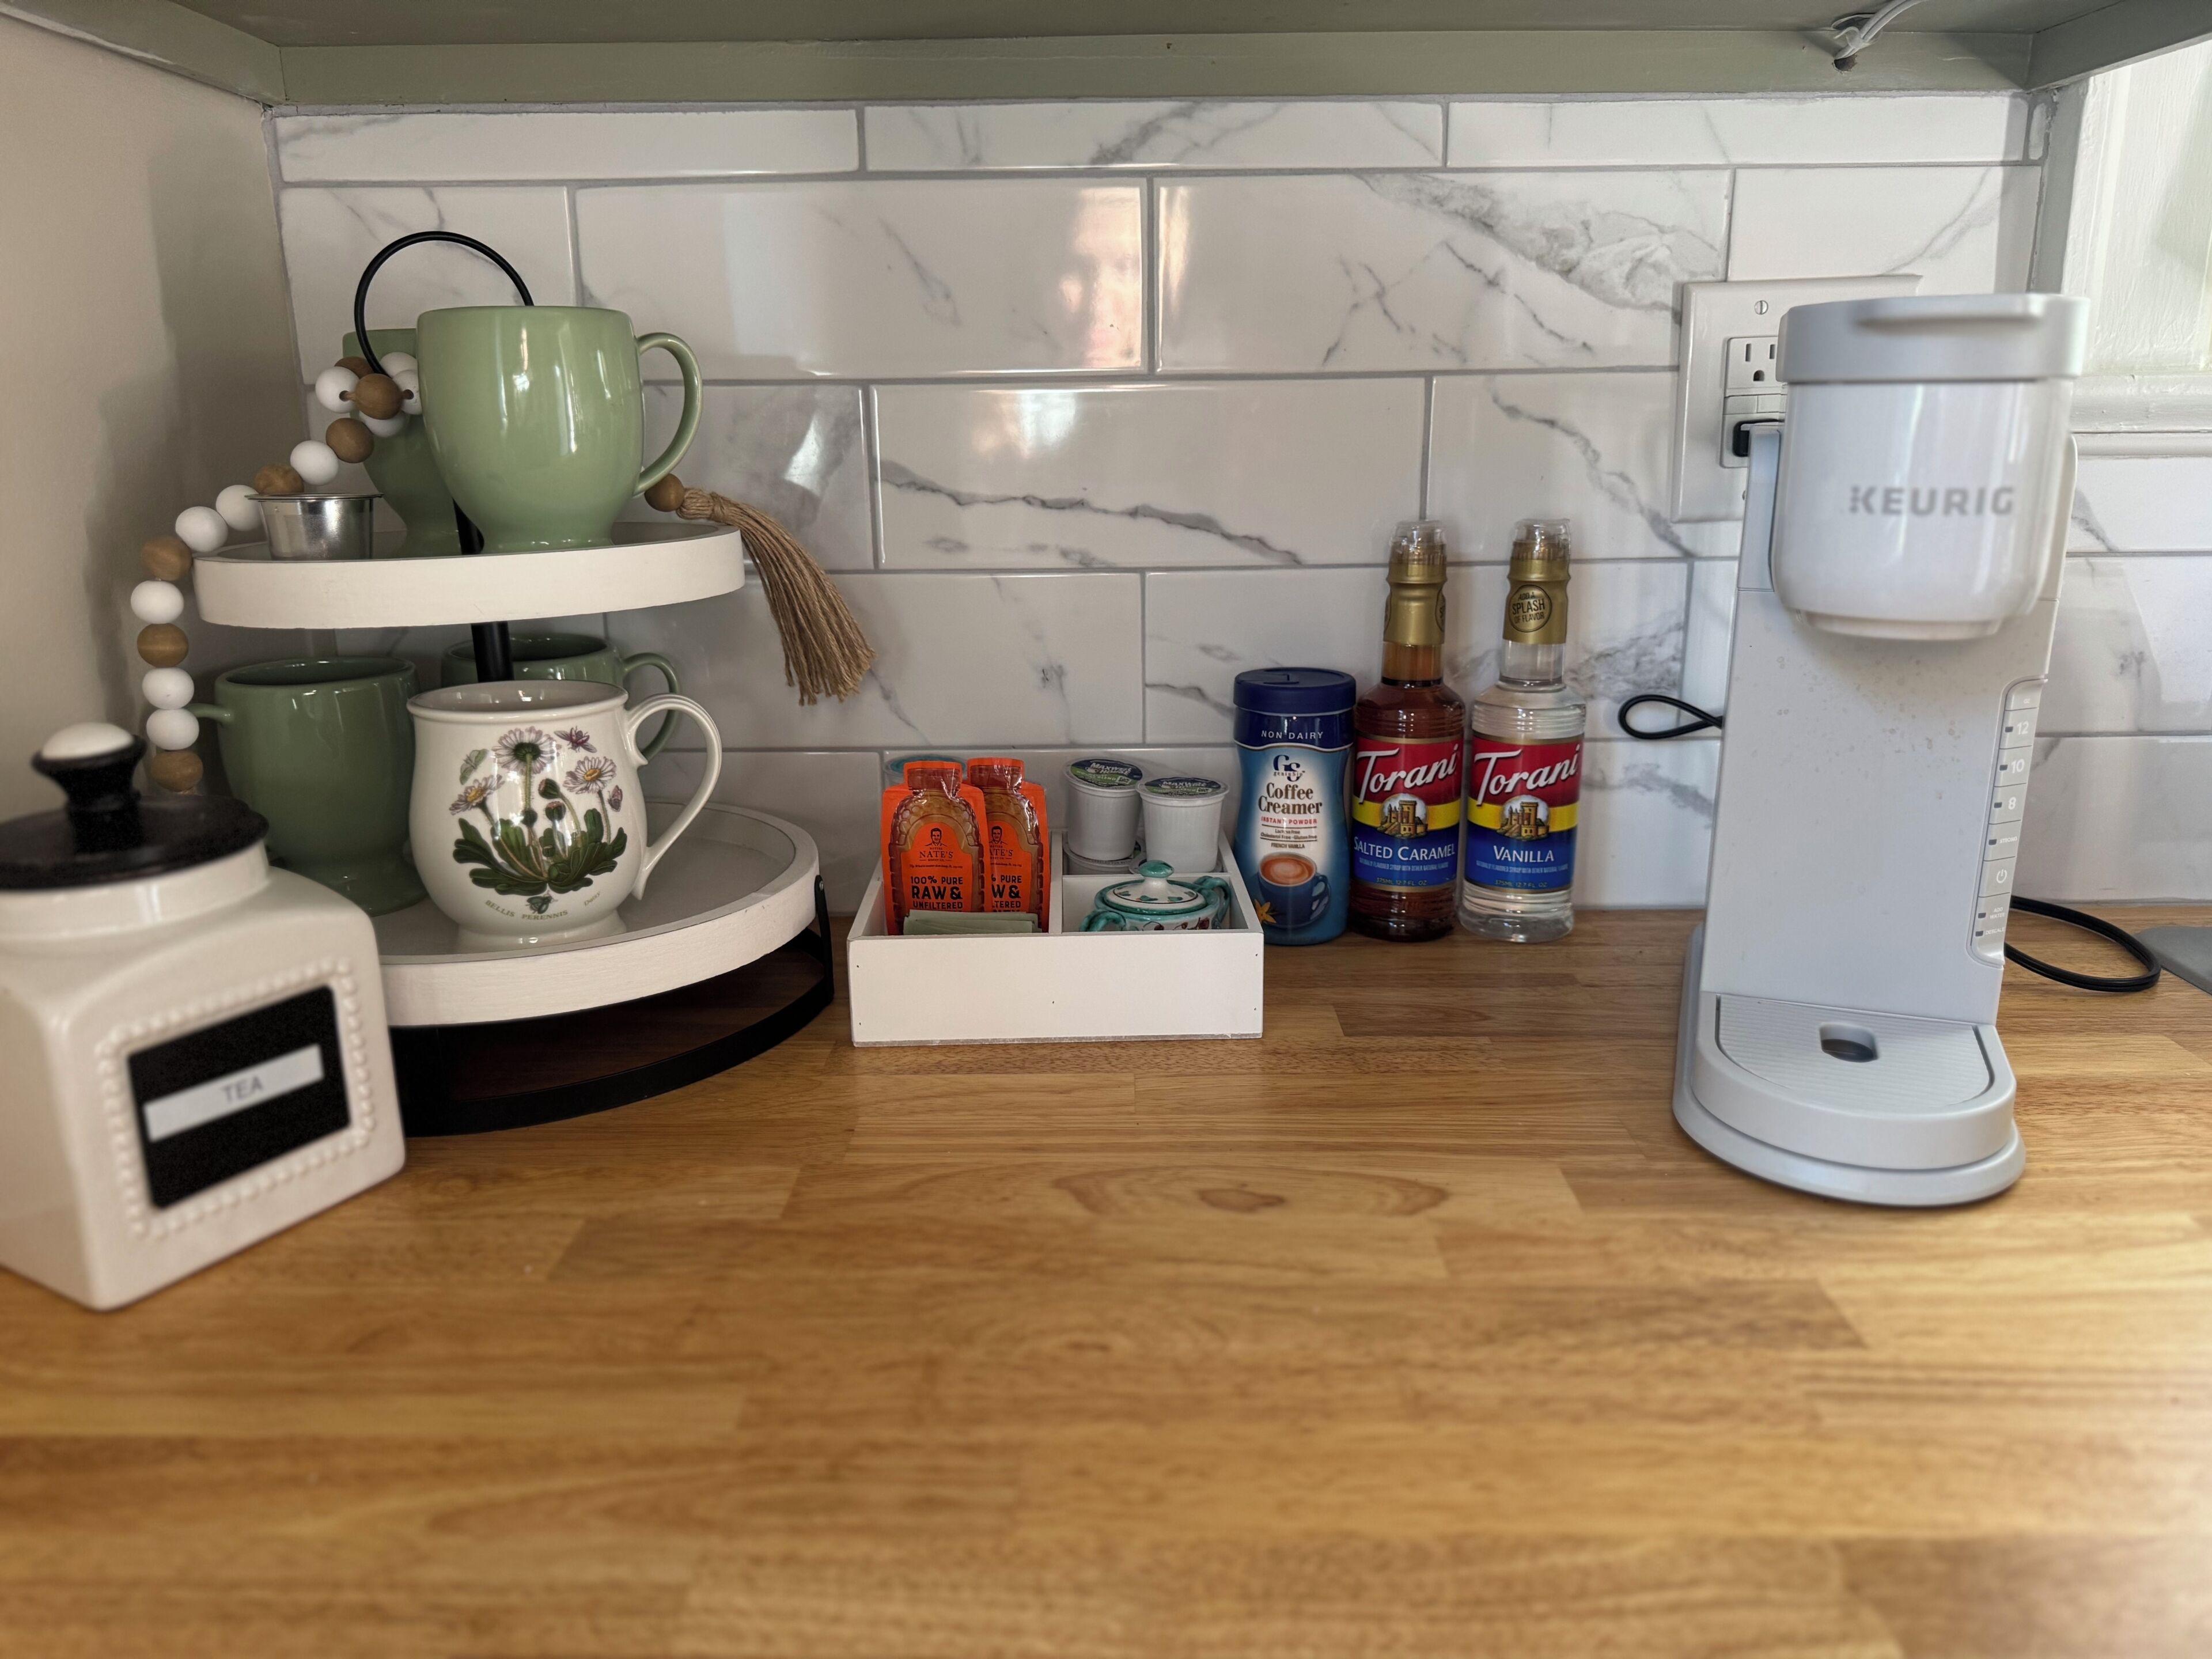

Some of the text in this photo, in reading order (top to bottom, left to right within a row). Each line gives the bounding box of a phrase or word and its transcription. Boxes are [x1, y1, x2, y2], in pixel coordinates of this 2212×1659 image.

[1849, 486, 2014, 516] KEURIG
[1512, 599, 1545, 615] SPLASH
[1522, 612, 1544, 622] FLAVOR
[1262, 730, 1323, 740] NON DAIRY
[2017, 721, 2029, 734] 12
[1357, 743, 1459, 804] Torani
[2011, 759, 2025, 774] 10
[1474, 744, 1580, 806] Torani
[1266, 782, 1313, 800] Coffee
[1258, 795, 1323, 815] Creamer
[2008, 797, 2017, 810] 8
[1354, 836, 1455, 861] SALTED CARAMEL
[1493, 845, 1554, 862] VANILLA
[911, 876, 963, 885] 100% PURE
[1001, 875, 1022, 884] PURE
[911, 885, 963, 900] RAW &
[1009, 884, 1021, 899] &
[485, 900, 569, 921] BELLIS PERENNIS
[912, 900, 963, 910] UNFILTERED
[221, 1075, 264, 1104] TEA
